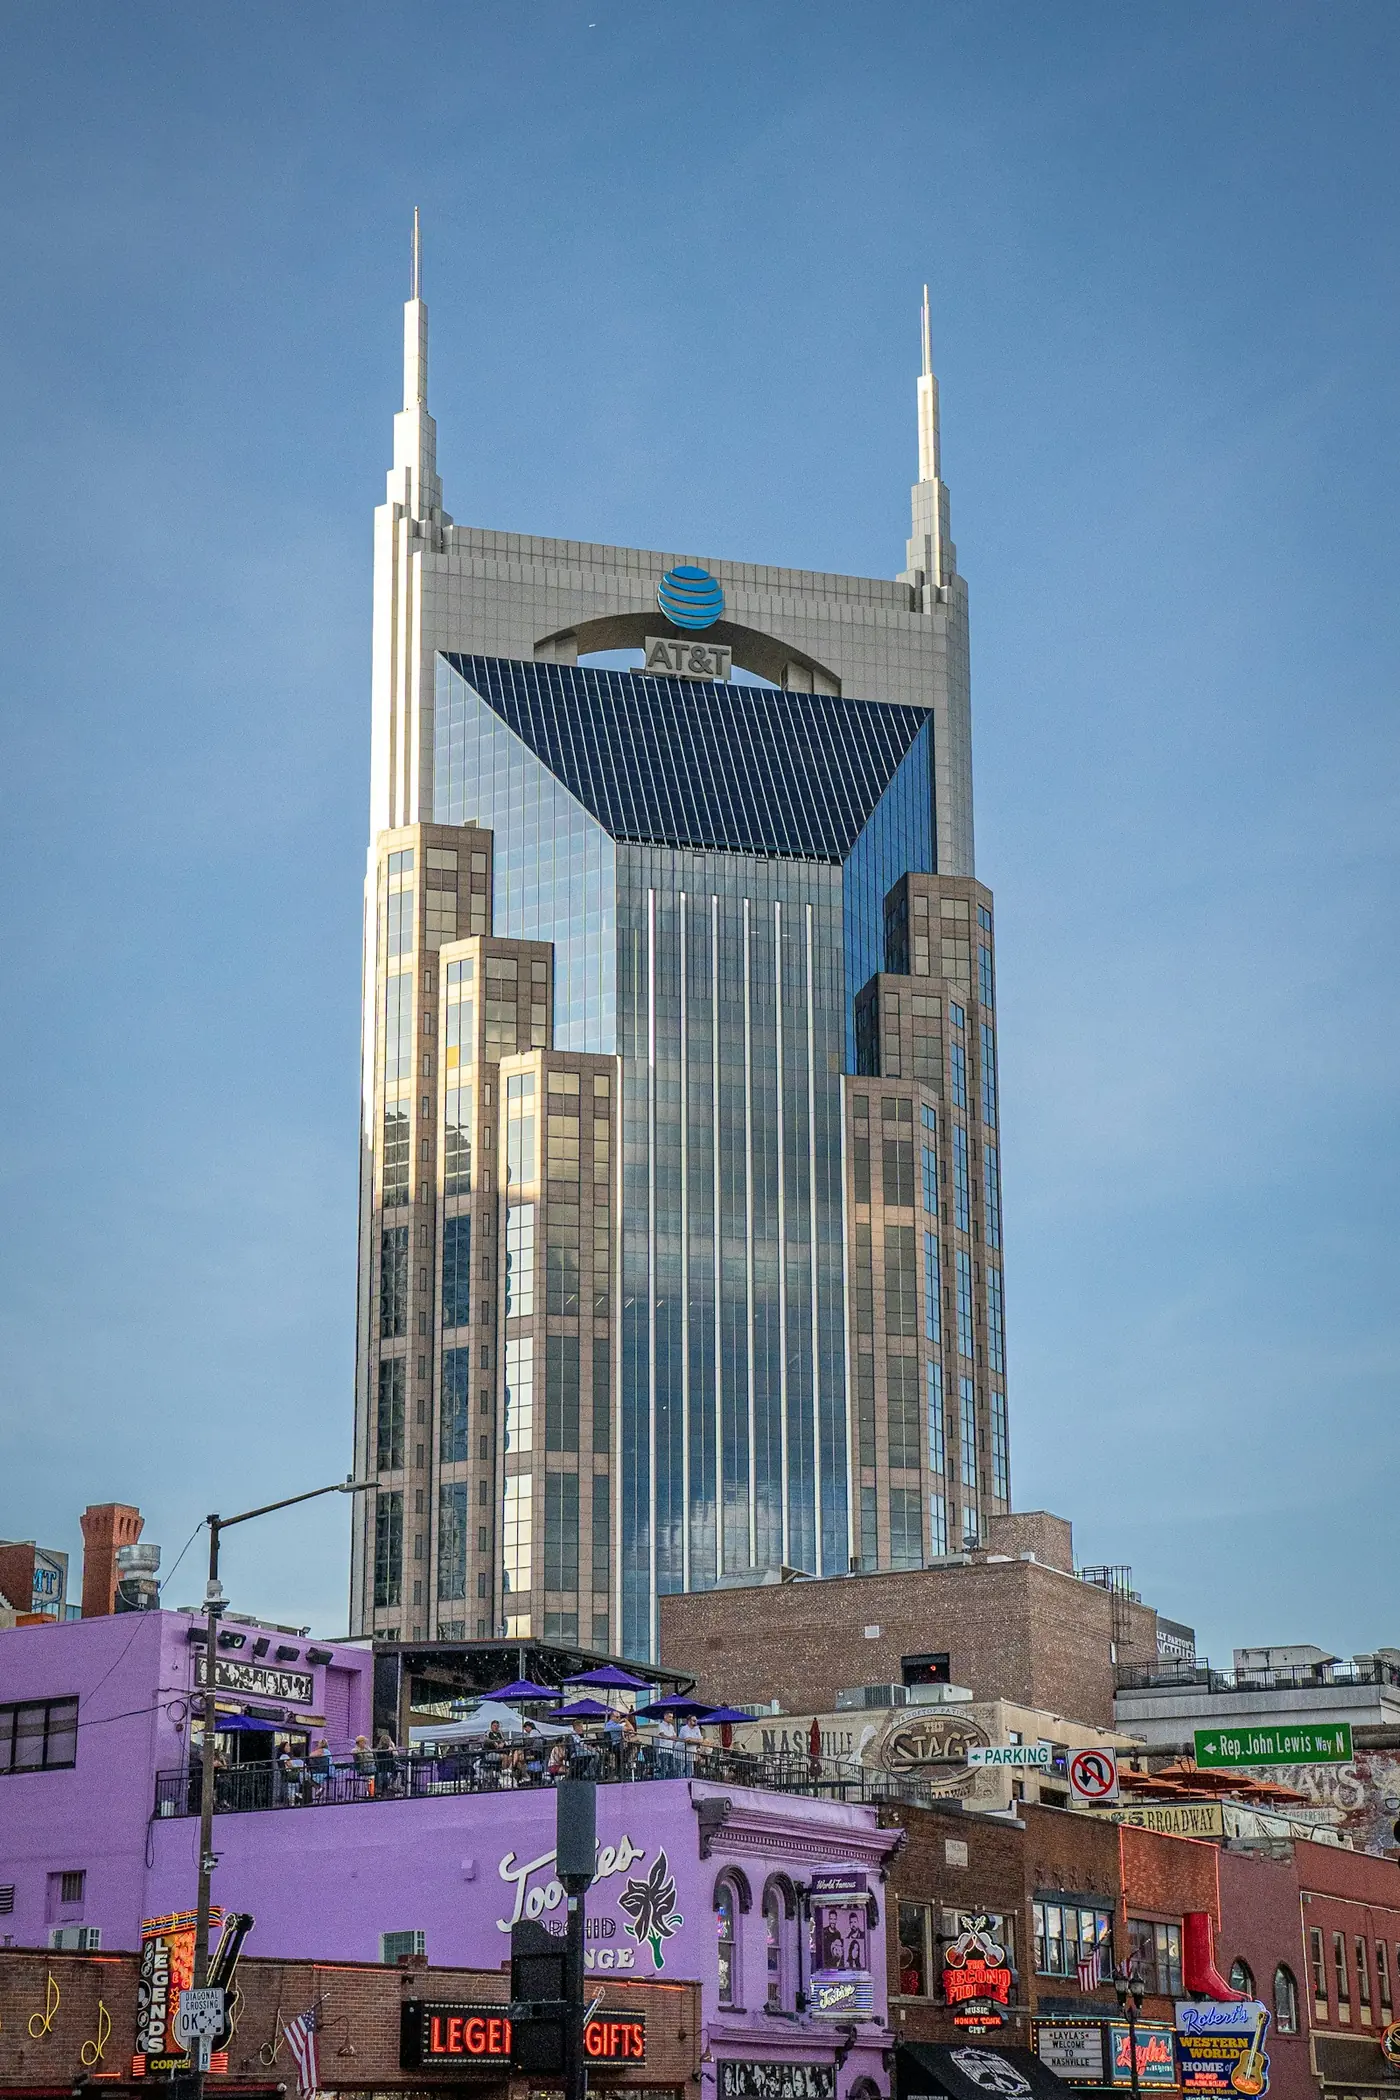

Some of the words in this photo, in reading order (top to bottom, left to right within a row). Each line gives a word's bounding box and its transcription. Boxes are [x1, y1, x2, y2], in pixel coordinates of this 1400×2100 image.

[647, 641, 730, 676] AT&T
[940, 1708, 965, 1717] PATIO
[923, 1721, 945, 1733] THE
[1219, 1735, 1245, 1760] Rep.
[1246, 1733, 1273, 1755] John
[1276, 1731, 1310, 1753] Lewis
[1315, 1737, 1332, 1756] Way
[1336, 1732, 1344, 1752] N
[985, 1747, 1048, 1764] PARKING
[1147, 1808, 1215, 1834] BROADWAY
[816, 1879, 835, 1890] World
[835, 1878, 856, 1888] Famous
[966, 1960, 985, 1970] THE
[942, 1968, 1011, 1988] SECOND
[147, 1937, 168, 2053] LEGENDS
[185, 1992, 219, 2001] DIAGONAL
[946, 1984, 1008, 2005] FIDDLE
[185, 2001, 219, 2011] CROSSING
[965, 2006, 989, 2015] MUSIC
[182, 2013, 198, 2031] OK
[954, 2017, 978, 2025] HONKY
[980, 2016, 1001, 2025] TONK
[1182, 2005, 1248, 2036] Robert's
[968, 2025, 986, 2034] CITY
[1053, 2031, 1085, 2039] LAYLA'S
[585, 2022, 643, 2057] GIFTS
[1052, 2040, 1085, 2049] WELCOME
[1179, 2037, 1248, 2048] WESTERN
[1064, 2049, 1074, 2057] TO
[1189, 2047, 1240, 2058] WORLD
[1051, 2057, 1090, 2066] NASHVILLE
[1182, 2061, 1224, 2072] HOME
[1224, 2061, 1234, 2075] of
